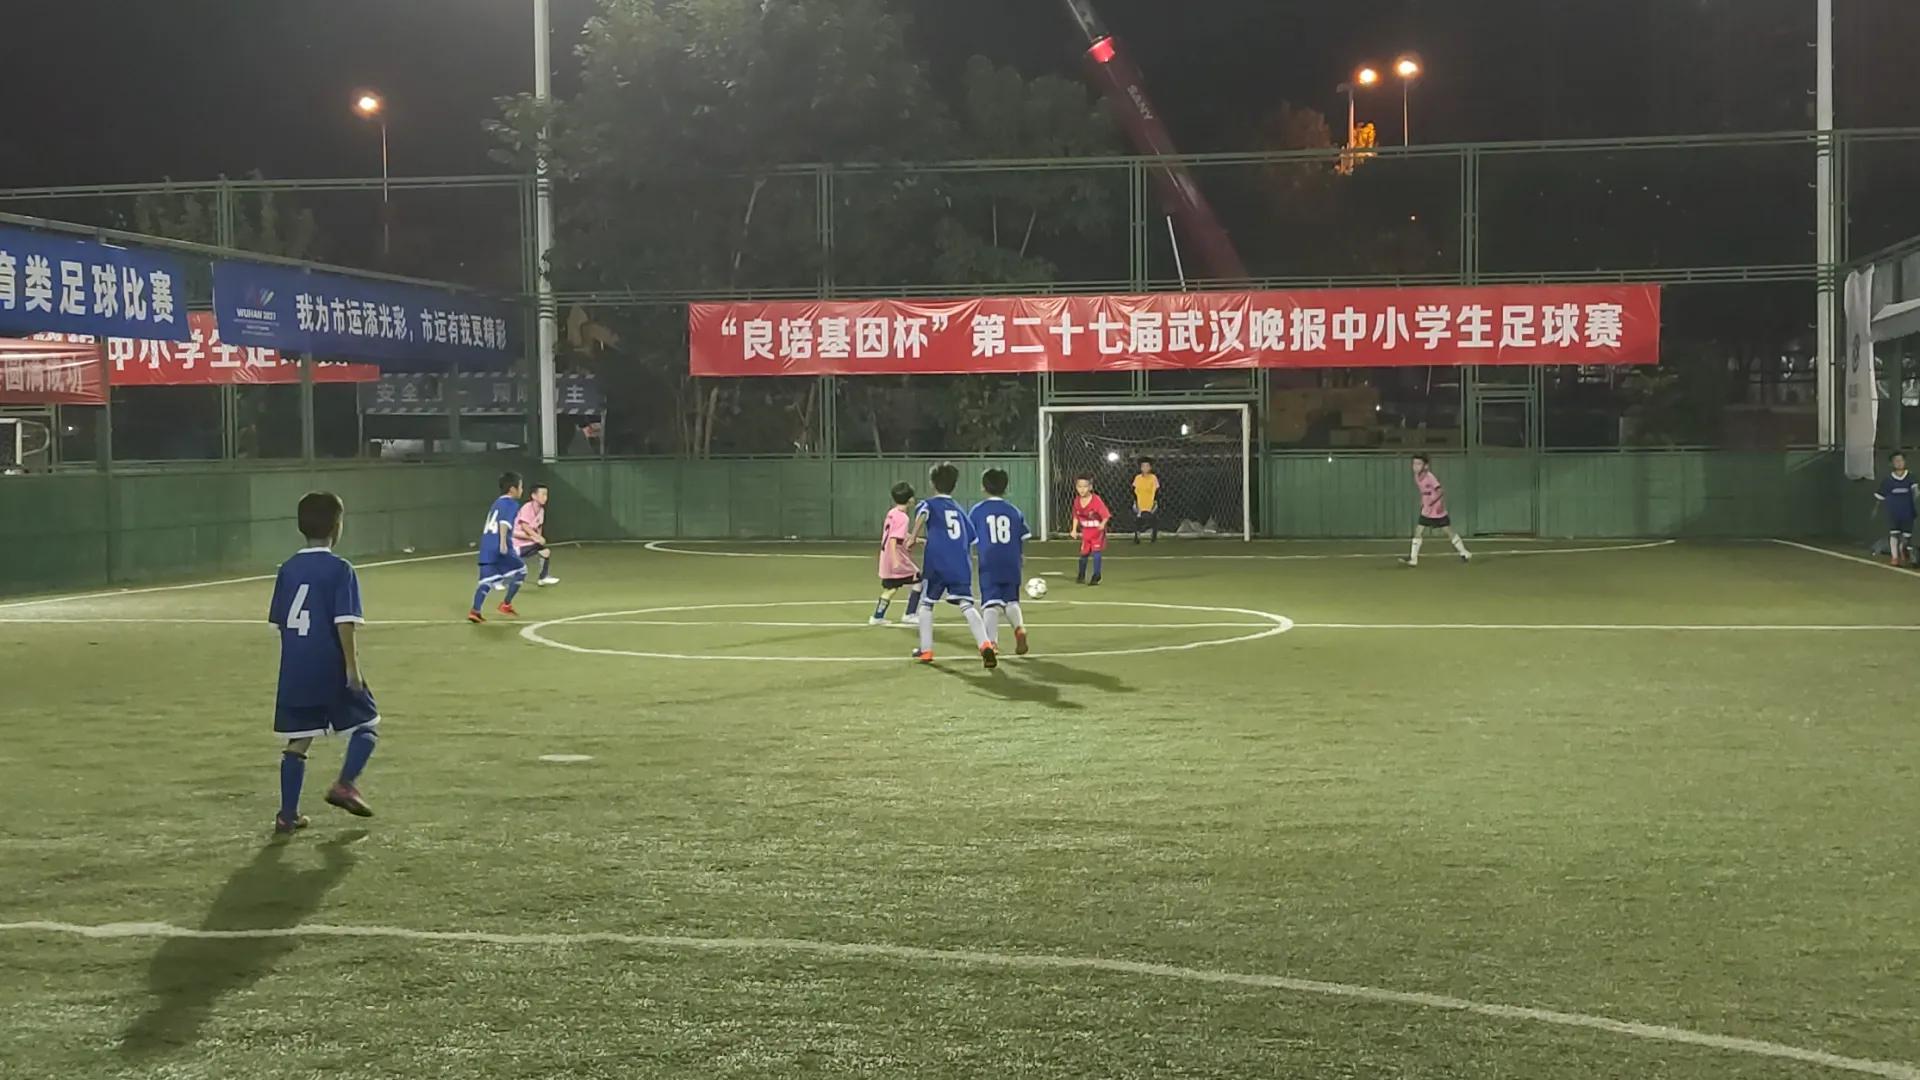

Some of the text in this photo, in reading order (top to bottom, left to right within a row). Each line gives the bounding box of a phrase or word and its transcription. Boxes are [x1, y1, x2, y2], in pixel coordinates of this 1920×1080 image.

[236, 308, 262, 319] WUHAN
[972, 303, 1624, 357] 第二十七届武汉晚报中小学生足球赛
[483, 509, 499, 535] 14
[944, 510, 962, 540] 5
[986, 514, 1011, 544] 18
[286, 583, 311, 637] 4
